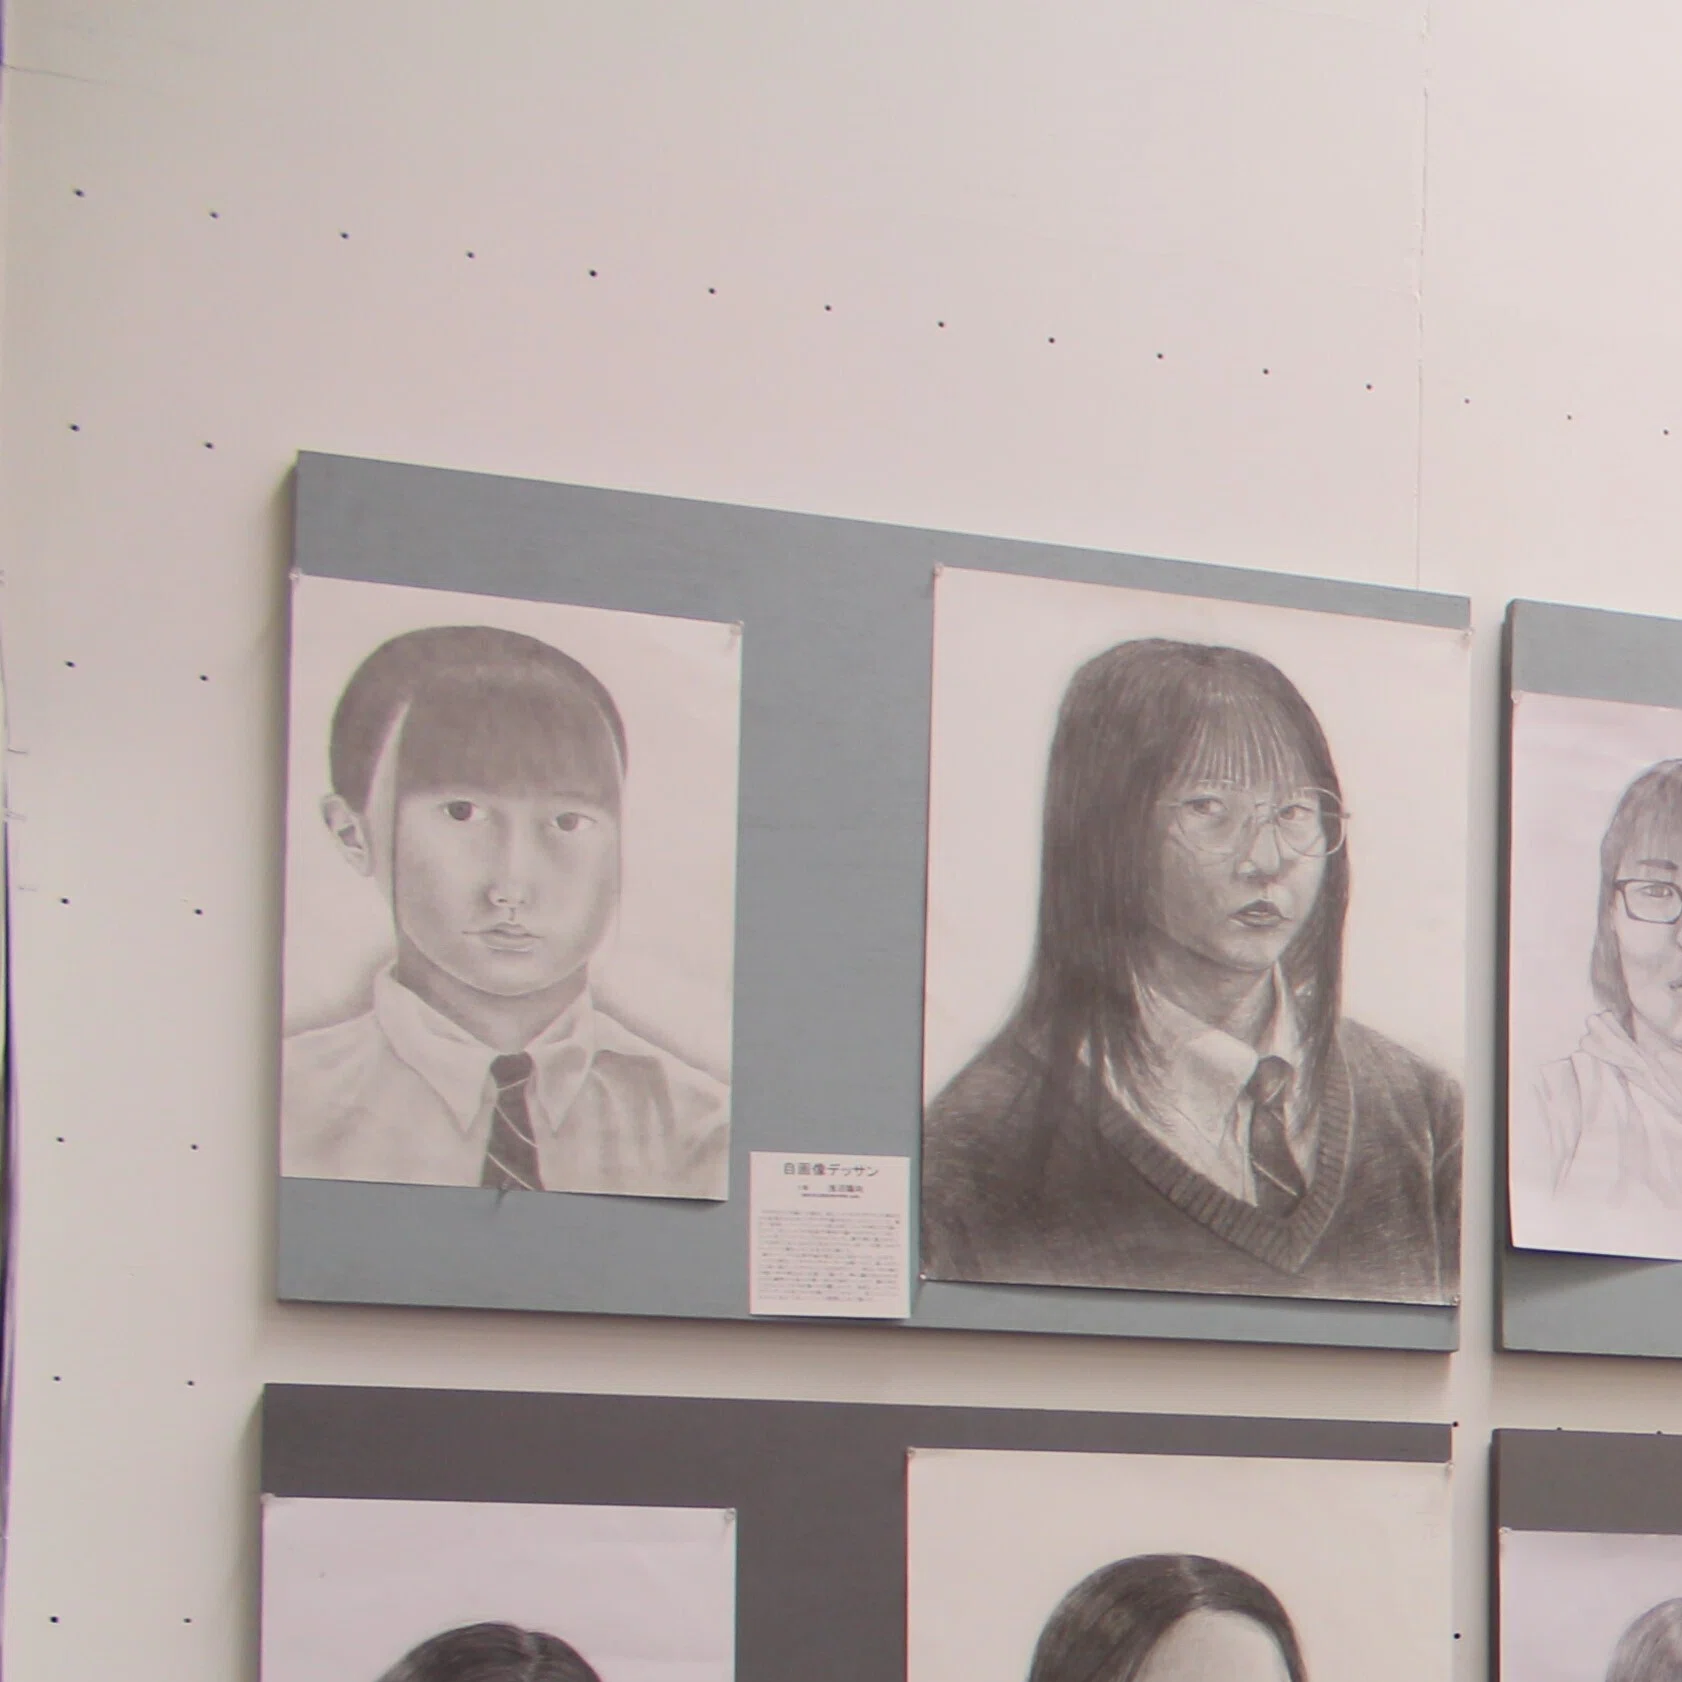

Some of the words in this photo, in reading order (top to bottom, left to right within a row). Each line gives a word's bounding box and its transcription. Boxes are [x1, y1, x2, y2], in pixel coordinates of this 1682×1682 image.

[784, 1163, 879, 1177] 自画像デッサン
